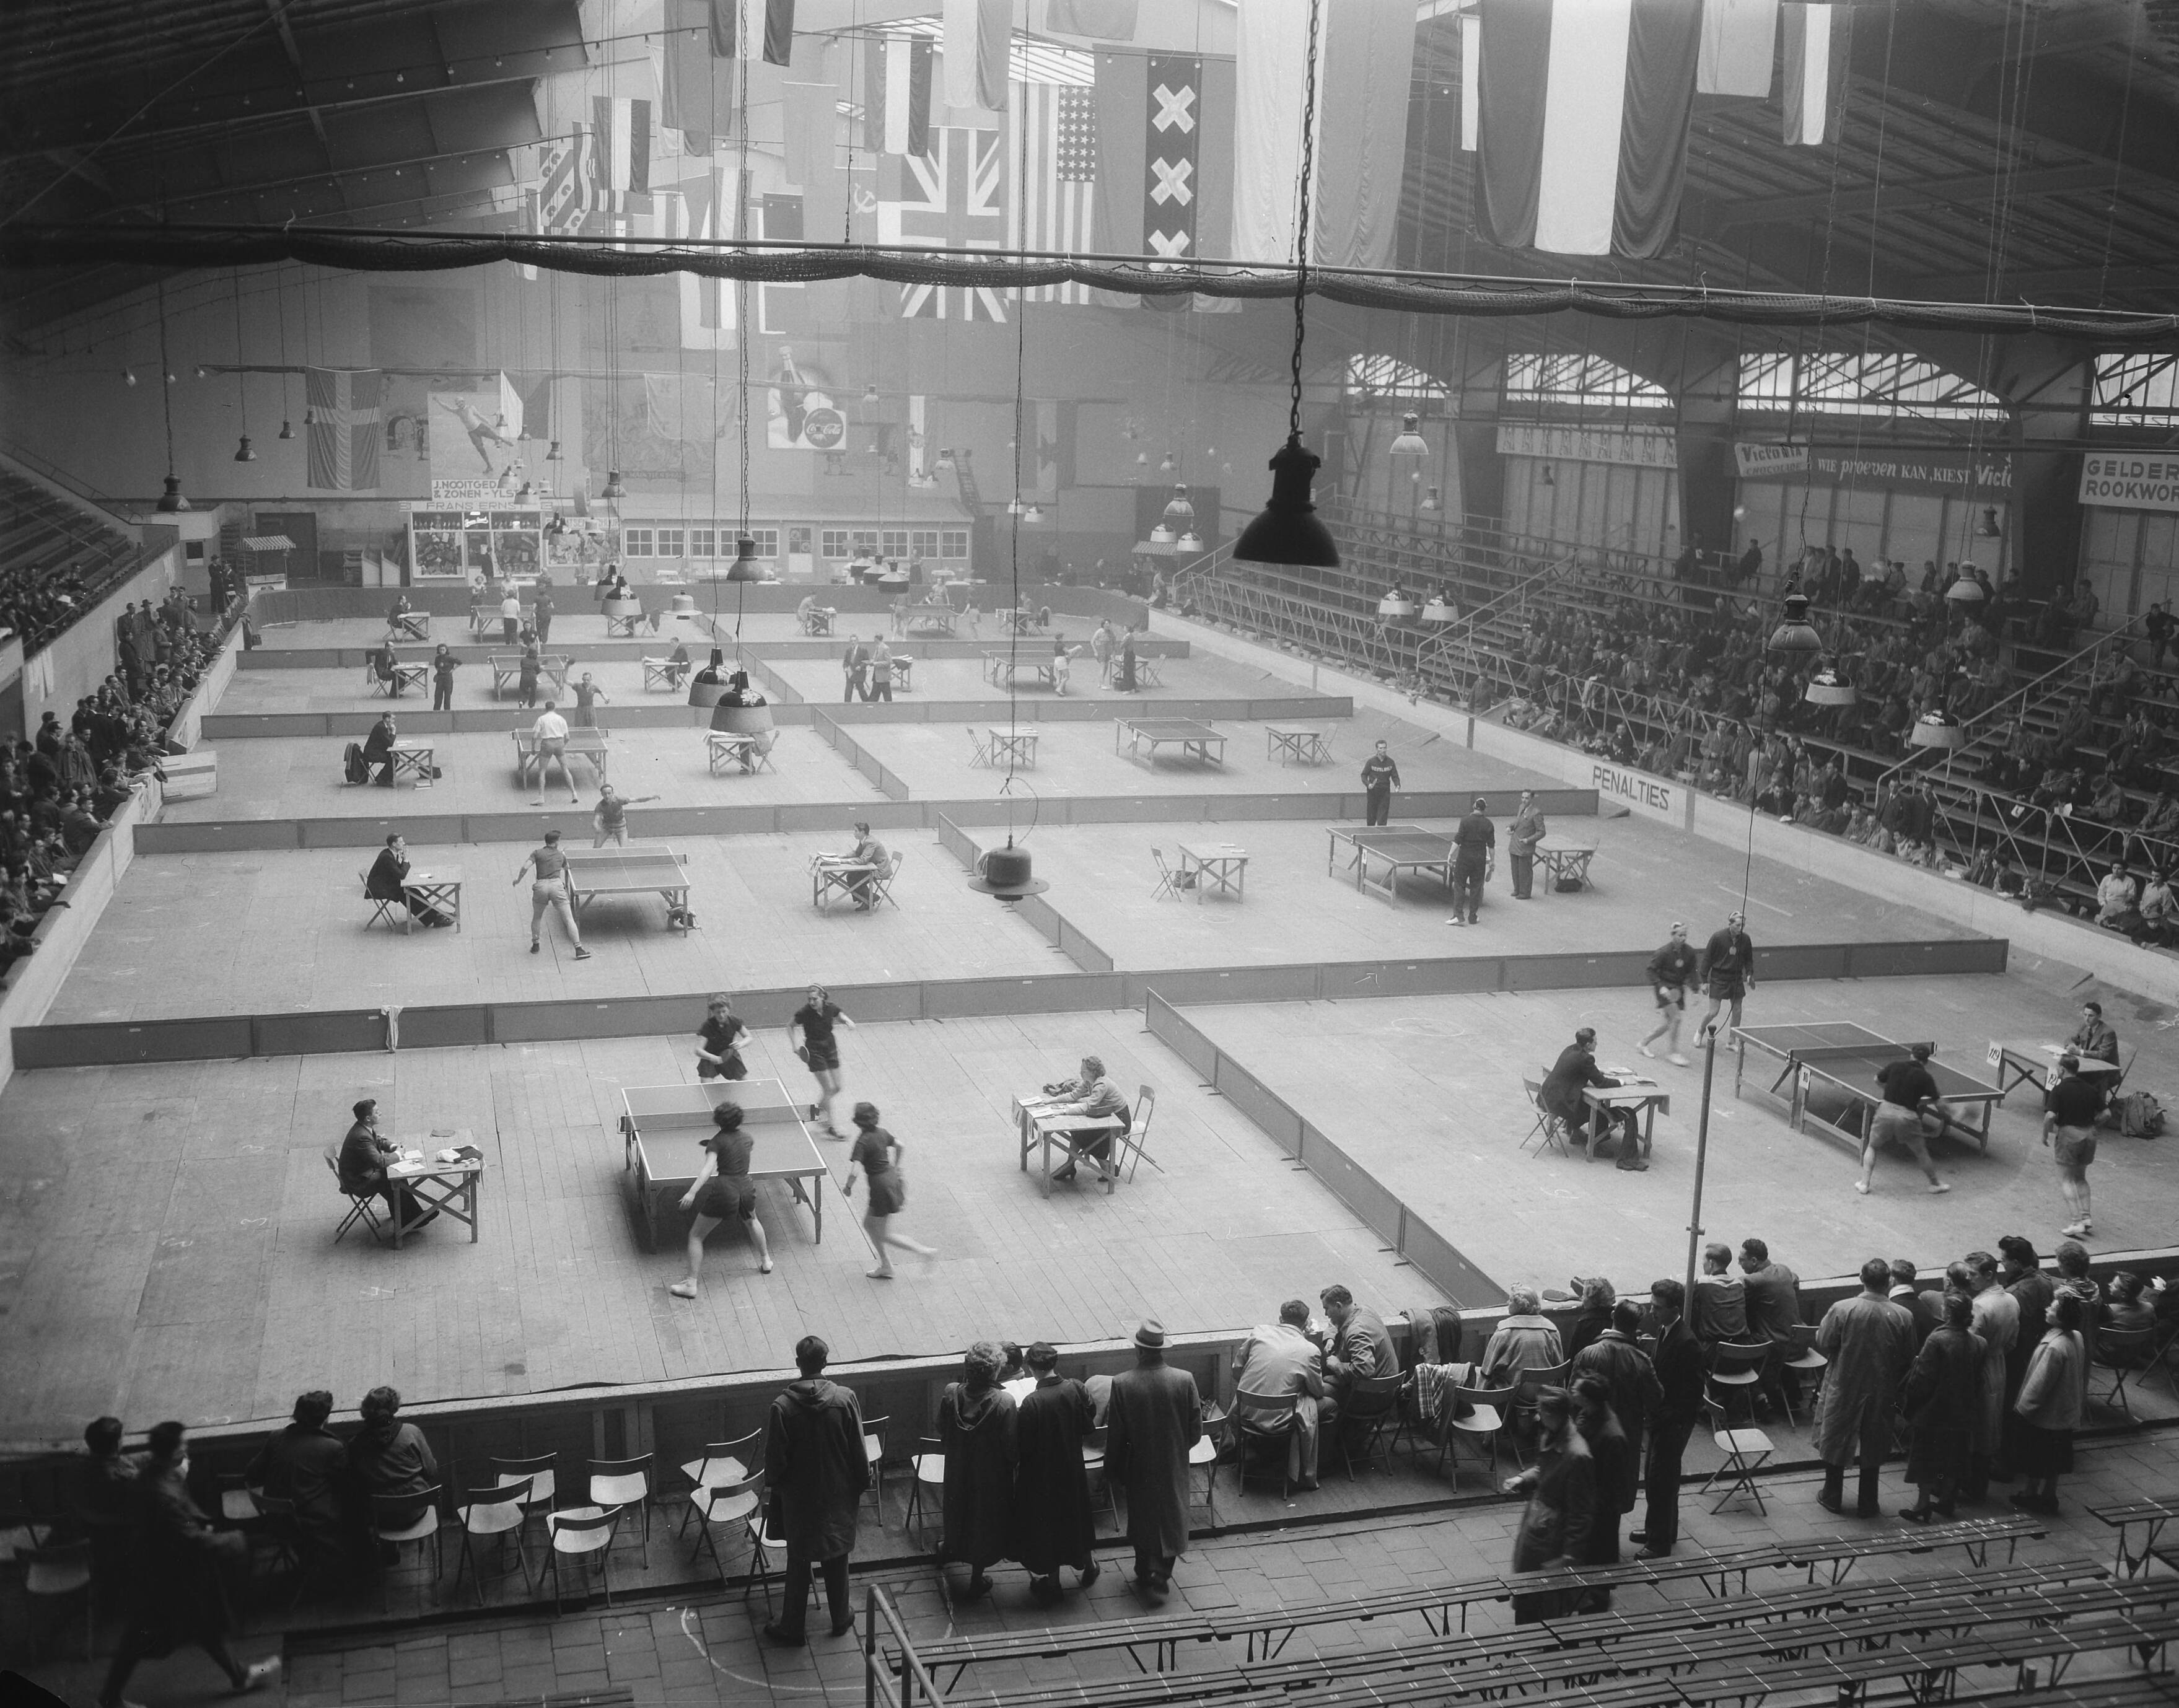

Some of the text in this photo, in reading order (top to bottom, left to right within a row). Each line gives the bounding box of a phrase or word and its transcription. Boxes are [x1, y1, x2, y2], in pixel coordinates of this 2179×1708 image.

[1818, 458, 1837, 472] WIE
[1839, 460, 1896, 481] proeven
[2087, 460, 2179, 480] GELDER
[434, 480, 497, 489] J.NOOITGED
[434, 490, 441, 498] &
[444, 489, 481, 498] ZONEN
[427, 502, 473, 510] FRANS
[1593, 766, 1669, 810] PENALTIES
[1988, 1048, 2000, 1061] 119
